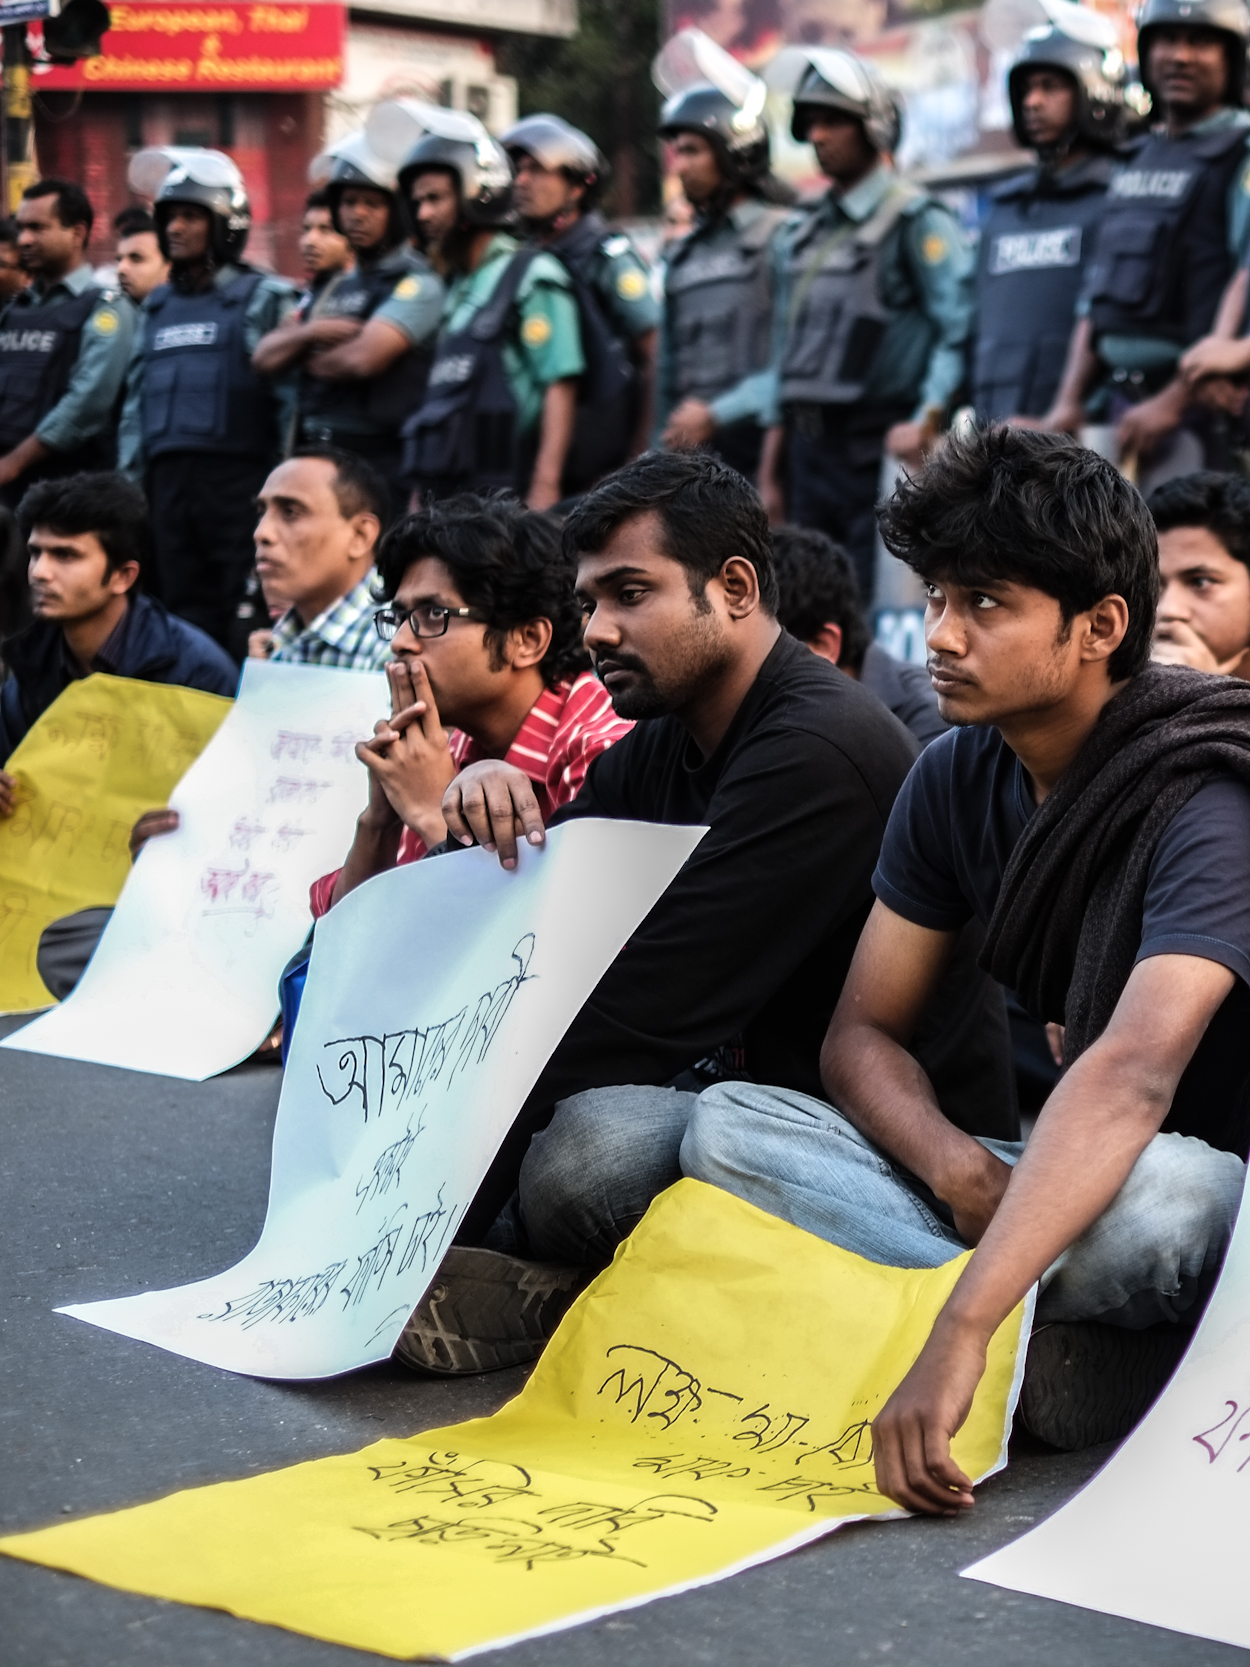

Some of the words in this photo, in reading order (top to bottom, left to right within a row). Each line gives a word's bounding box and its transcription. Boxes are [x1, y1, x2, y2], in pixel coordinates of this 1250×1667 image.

[249, 5, 309, 33] Thai
[82, 54, 194, 82] Chinese
[197, 56, 341, 82] Restaurant
[316, 1005, 468, 1123] আমাদের
